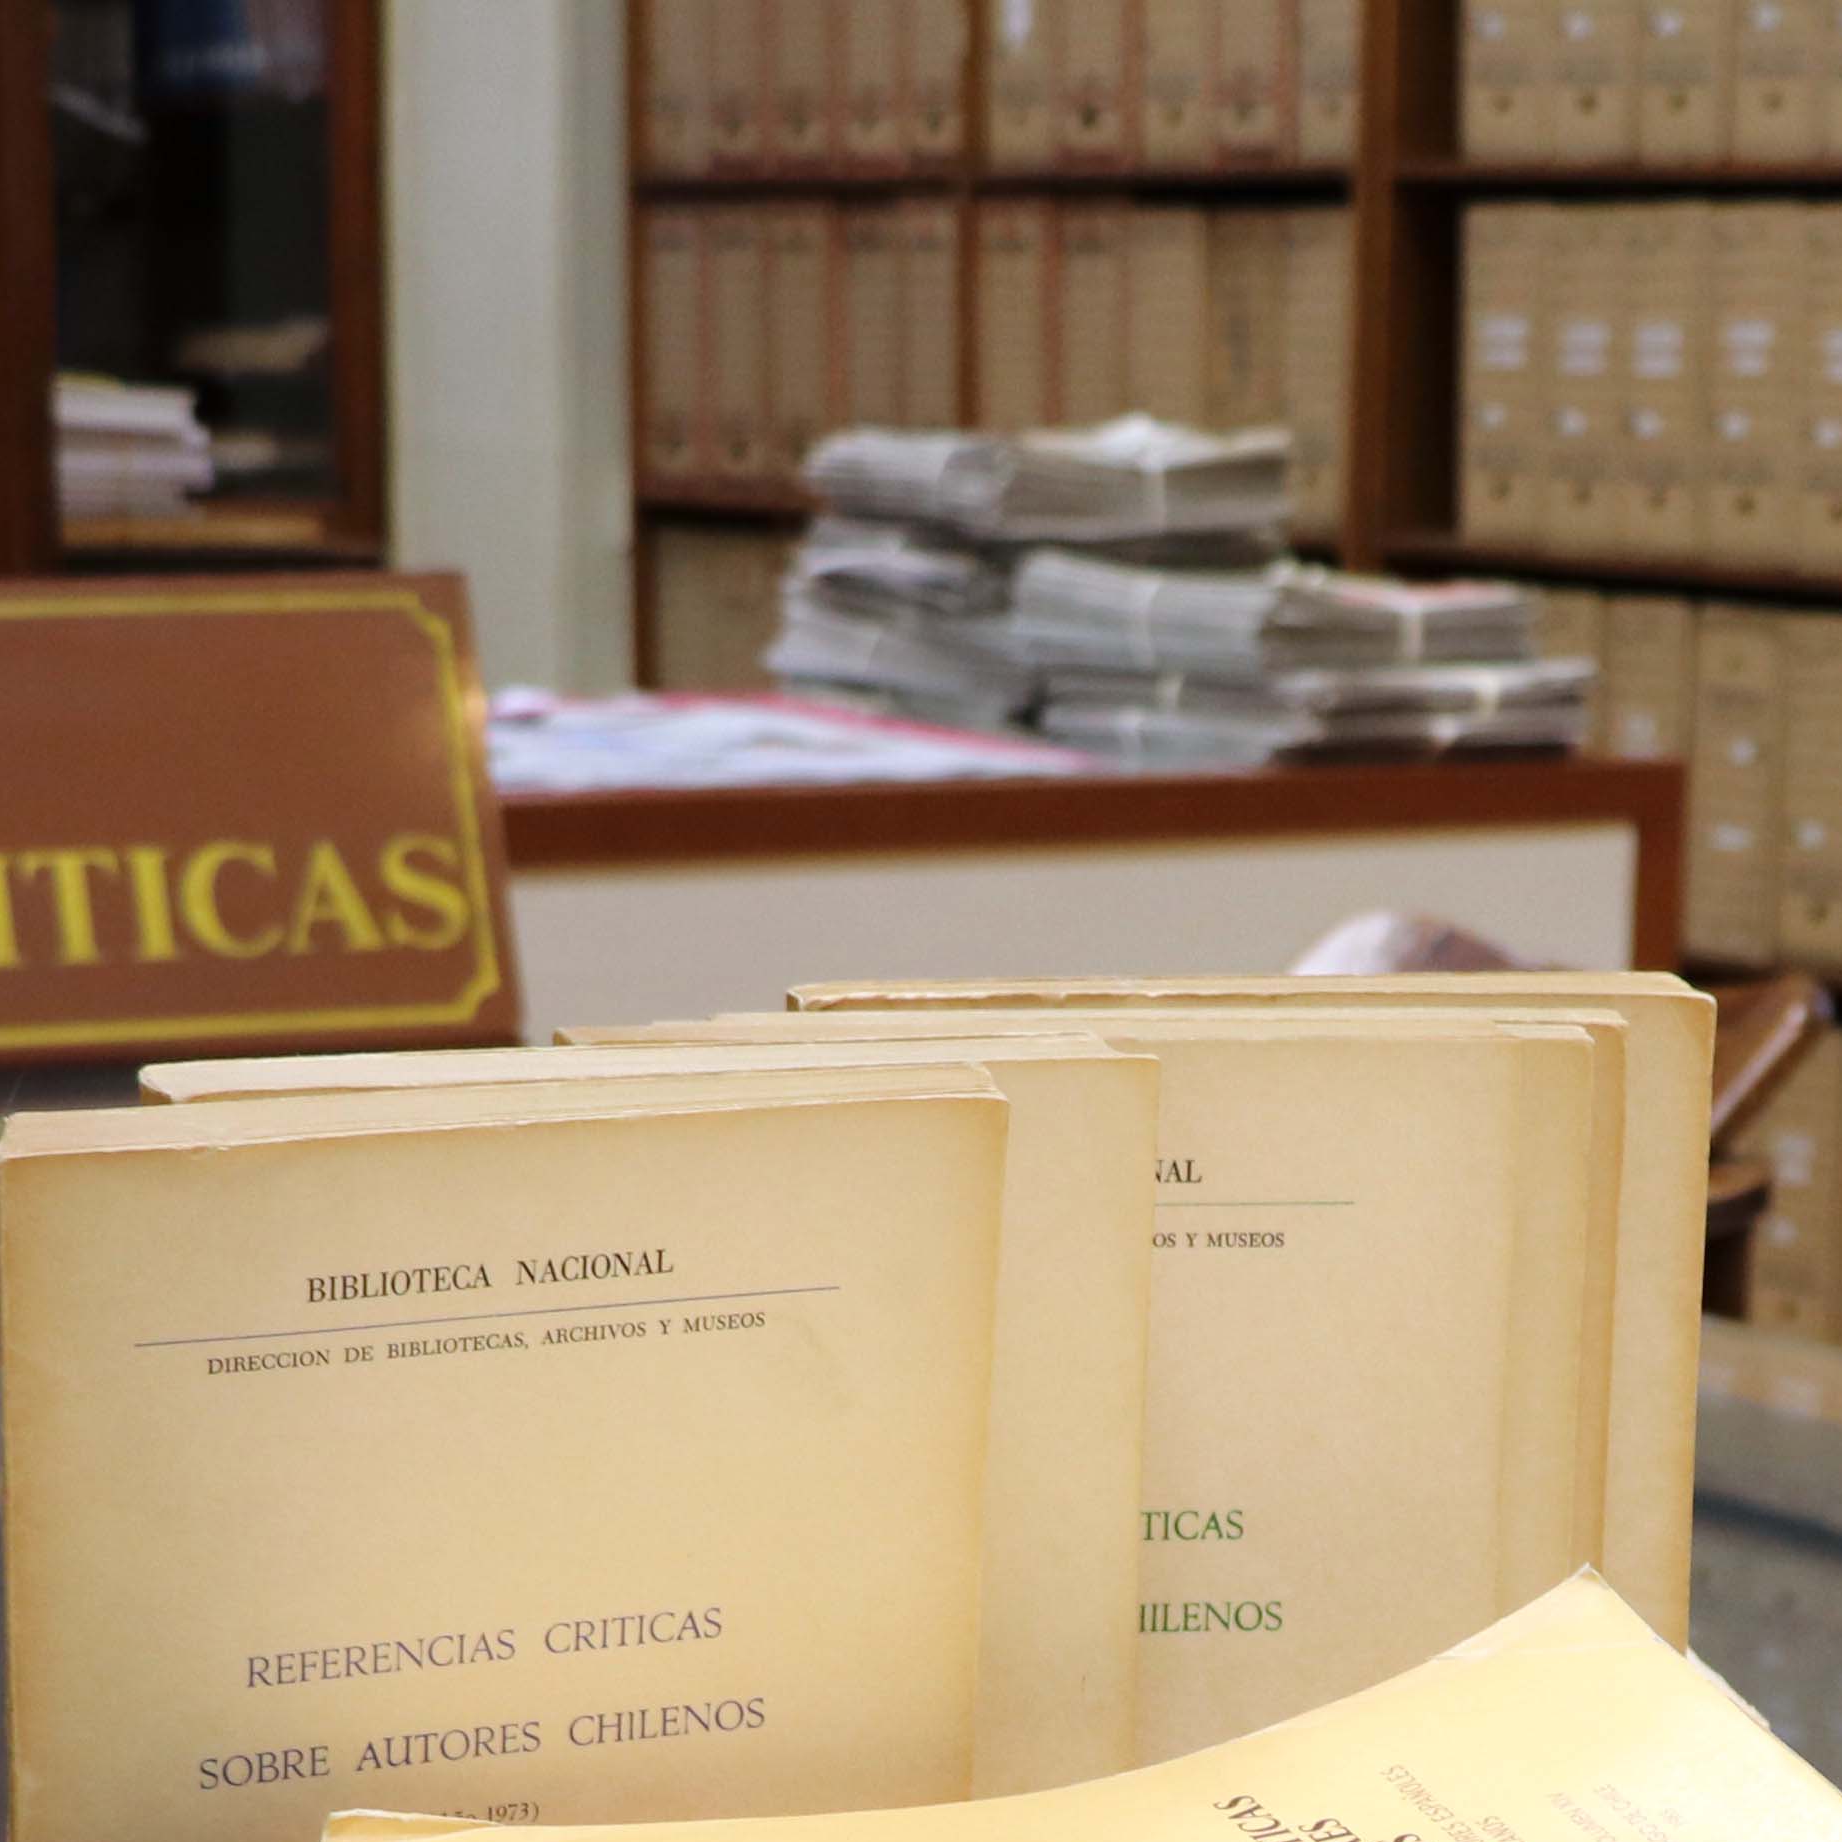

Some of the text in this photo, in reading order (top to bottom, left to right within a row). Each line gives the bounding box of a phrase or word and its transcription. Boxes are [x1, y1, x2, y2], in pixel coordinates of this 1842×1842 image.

[1185, 1232, 1199, 1248] Y
[1207, 1232, 1285, 1248] MUSEOS
[306, 1247, 673, 1304] BIBLIOTECA NACIONAL
[206, 1311, 766, 1376] DIRECCION DE BIBLIOTECAS, ARCHIVOS Y MUSEOS
[1140, 1510, 1244, 1541] TICAS
[245, 1606, 723, 1690] REFERENCIAS CRITICAS
[198, 1697, 767, 1792] SOBRE AUTORES CHILENOS
